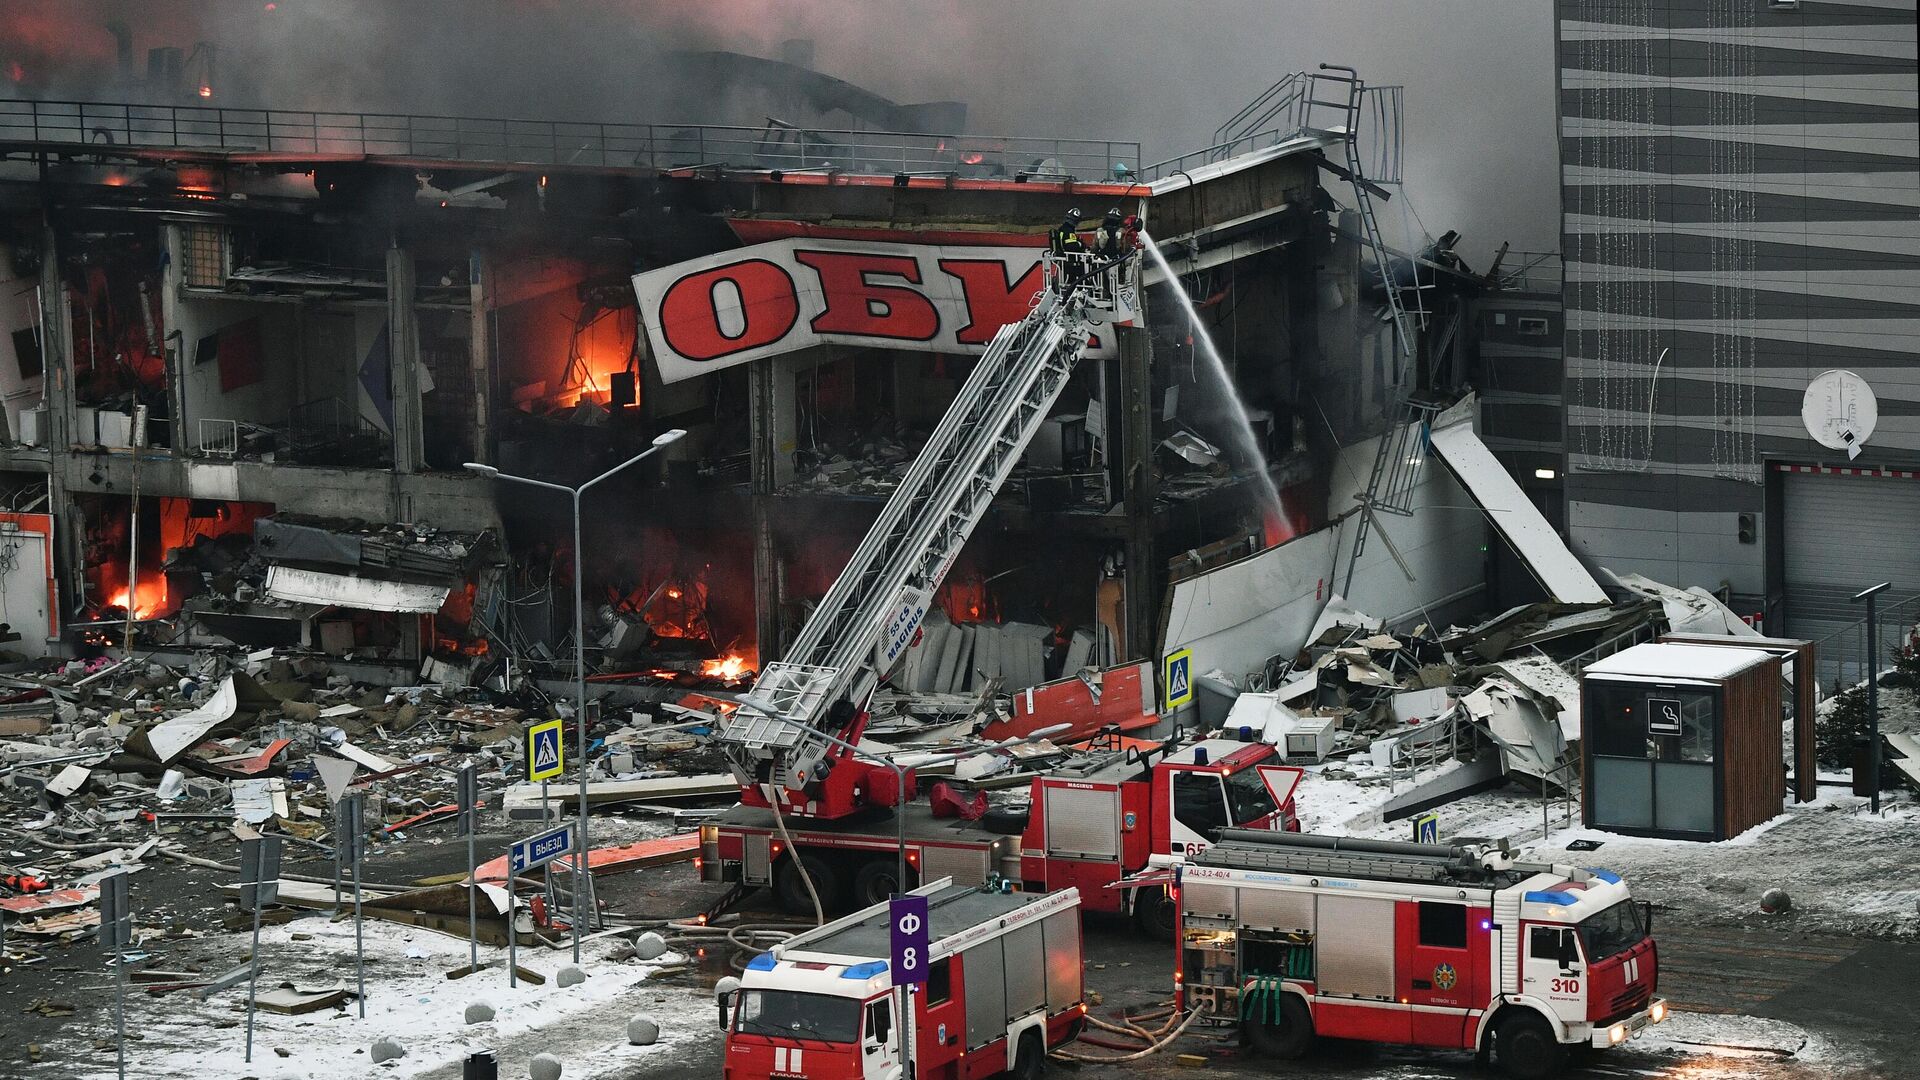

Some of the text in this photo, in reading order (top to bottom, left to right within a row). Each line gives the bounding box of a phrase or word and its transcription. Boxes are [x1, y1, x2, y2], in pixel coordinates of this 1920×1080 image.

[890, 620, 899, 637] 55
[899, 605, 910, 623] CS
[887, 606, 923, 661] MAGIRUS
[536, 836, 562, 856] ВЫЕЗД
[1189, 868, 1230, 880] АЦ-3,2-40/4
[899, 912, 920, 935] Ф
[903, 947, 917, 970] 8
[1551, 978, 1580, 993] 310
